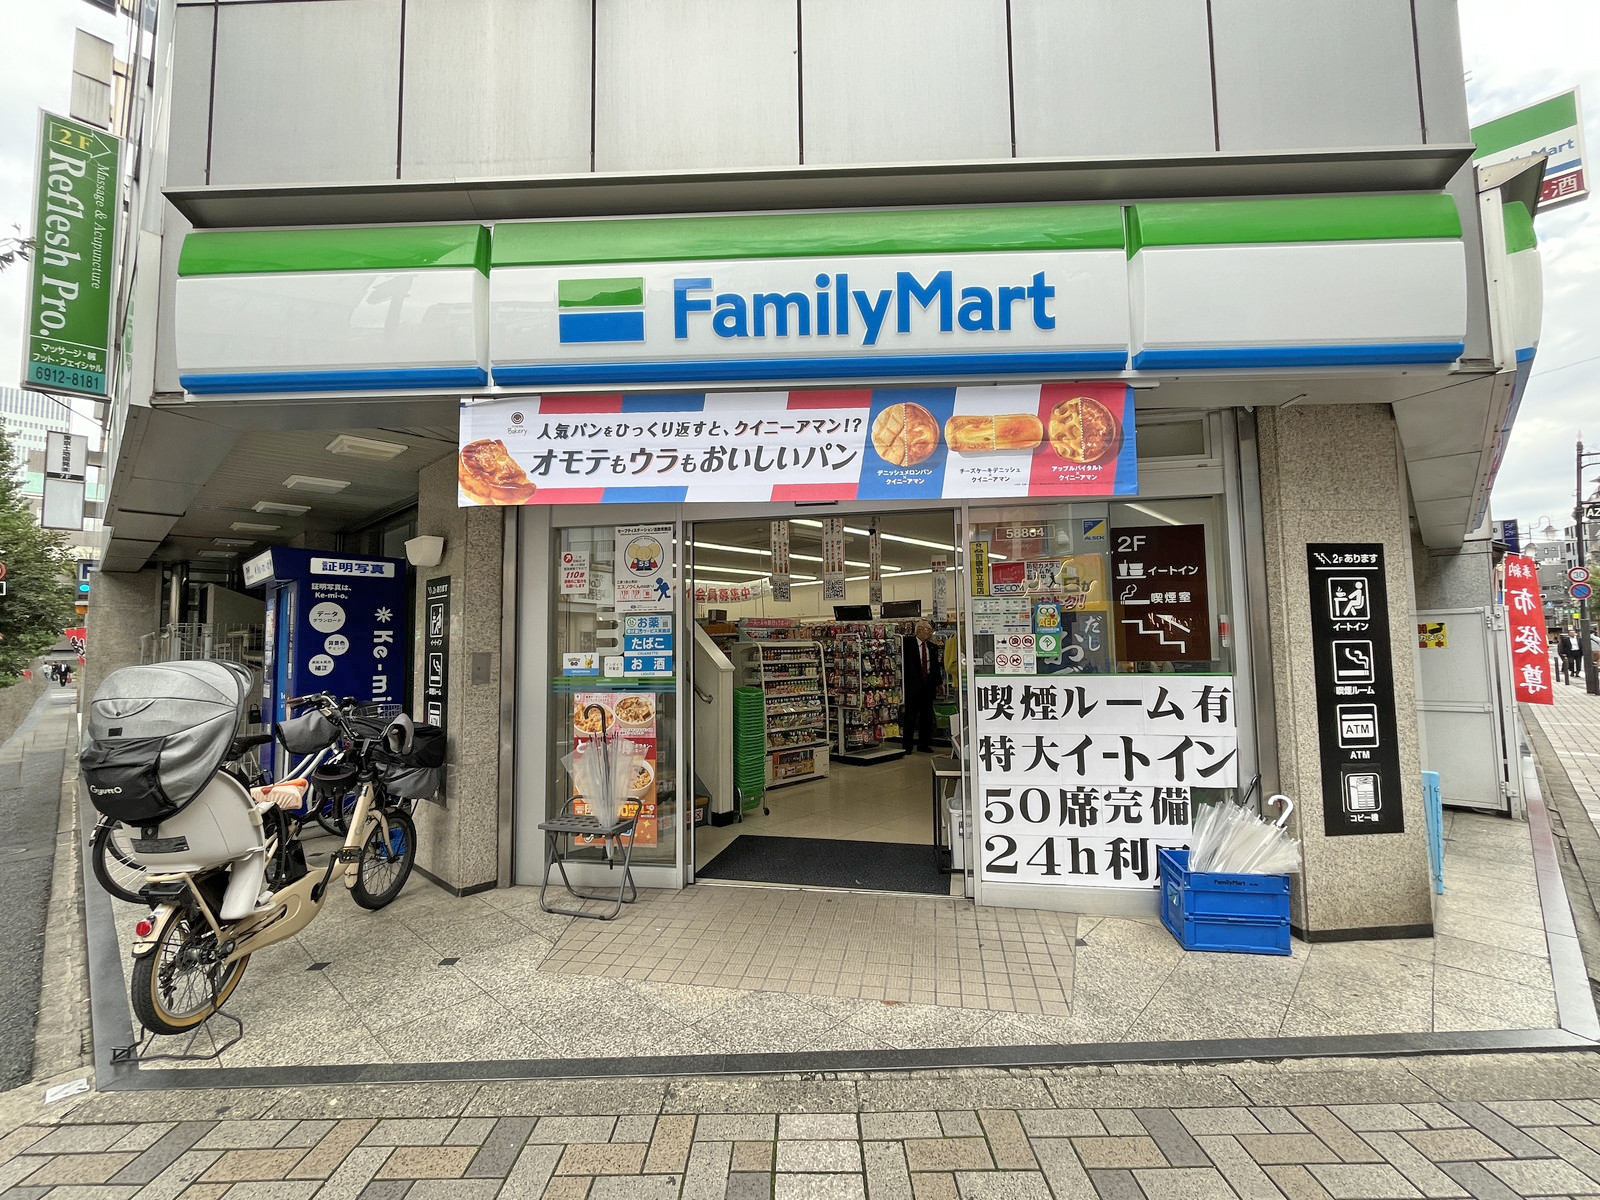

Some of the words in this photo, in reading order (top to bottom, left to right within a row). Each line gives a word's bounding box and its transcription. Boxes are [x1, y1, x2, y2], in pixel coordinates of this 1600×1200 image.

[59, 128, 93, 150] 2F
[93, 163, 110, 207] Massage
[43, 148, 87, 267] Reflesh
[94, 209, 108, 220] &
[91, 221, 107, 289] Acupuncture
[40, 274, 79, 336] Pro.
[673, 270, 1056, 346] FamilyMart
[35, 366, 99, 390] 6912-8181
[529, 442, 858, 477] オモテもウラもおいしいパン
[1117, 535, 1147, 553] 2F
[1332, 553, 1378, 564] 2Fあります
[322, 561, 385, 575] 証明写真
[1147, 565, 1199, 576] イートイン
[1573, 571, 1586, 580] 30
[1151, 592, 1192, 604] 喫煙室
[637, 616, 660, 628] お薬
[1038, 618, 1058, 628] AED
[1333, 622, 1369, 632] イートイン
[1084, 616, 1103, 652] だし
[631, 637, 665, 650] たばこ
[1335, 685, 1376, 696] 喫煙ルーム
[977, 684, 1232, 723] 喫煙ルーム有
[1345, 724, 1370, 735] ATM
[978, 734, 1237, 782] 特大イートイン
[1350, 750, 1371, 760] ATM
[984, 785, 1189, 828] 50席完備
[1350, 813, 1379, 823] コピー機
[1213, 879, 1246, 887] FamilyMart
